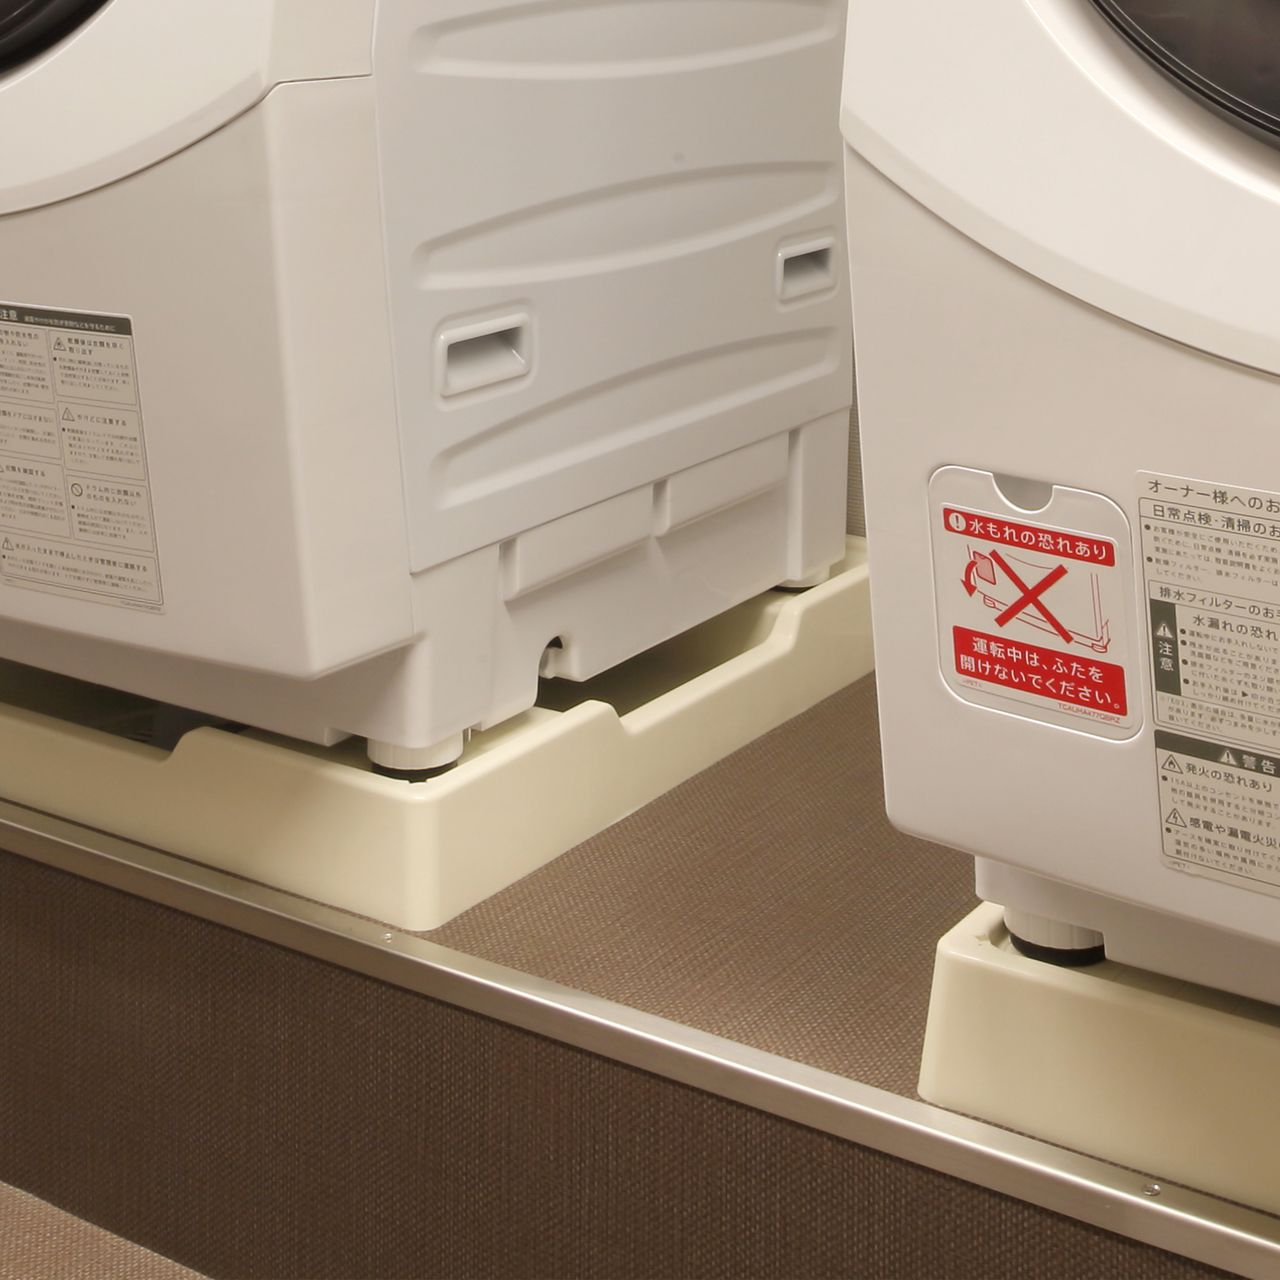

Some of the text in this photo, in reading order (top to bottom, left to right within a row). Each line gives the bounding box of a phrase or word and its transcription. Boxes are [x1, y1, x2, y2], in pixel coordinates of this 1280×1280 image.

[0, 309, 18, 321] 注意
[968, 518, 1107, 561] 水もれの恐れあり
[972, 636, 1105, 684] 運転中は、ふたを
[1158, 641, 1174, 671] 注意
[960, 654, 1120, 709] 開けないでください。
[1185, 763, 1273, 793] 発火の恐れあり
[1242, 753, 1276, 774] 警告
